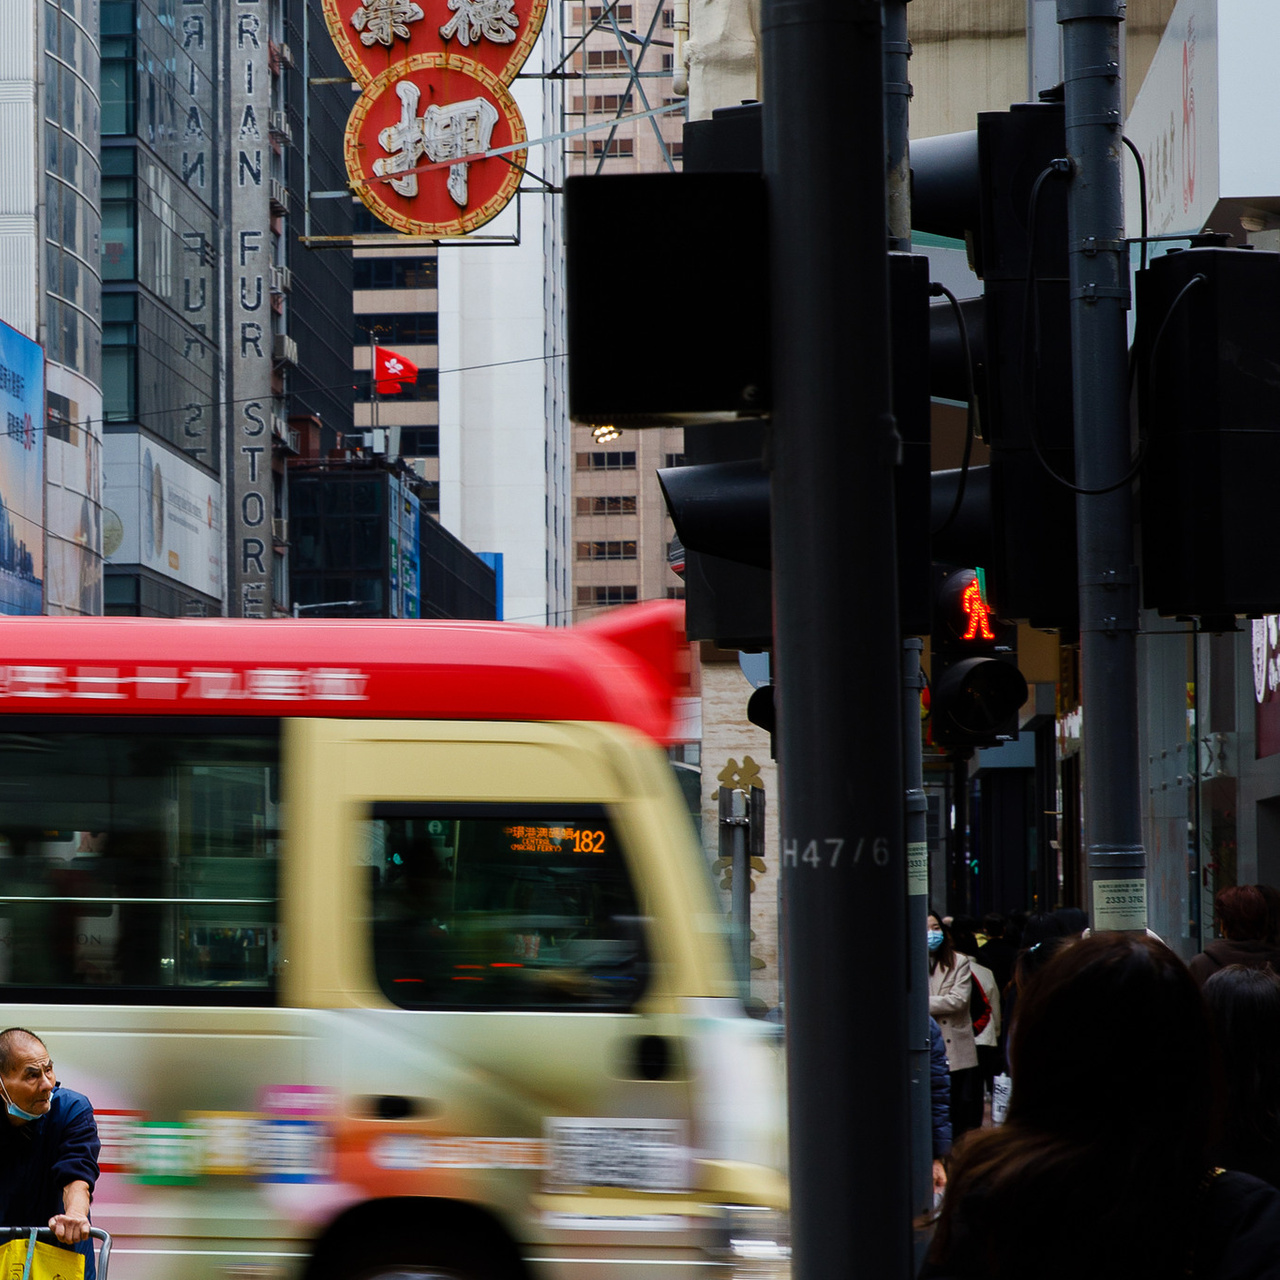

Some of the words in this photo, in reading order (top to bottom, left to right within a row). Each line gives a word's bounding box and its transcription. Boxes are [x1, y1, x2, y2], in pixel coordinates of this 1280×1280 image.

[372, 79, 500, 207] 押
[238, 229, 264, 360] FUR
[241, 401, 267, 618] STORE
[573, 829, 606, 853] 182
[782, 837, 890, 868] H47/6
[1105, 896, 1126, 904] 2333
